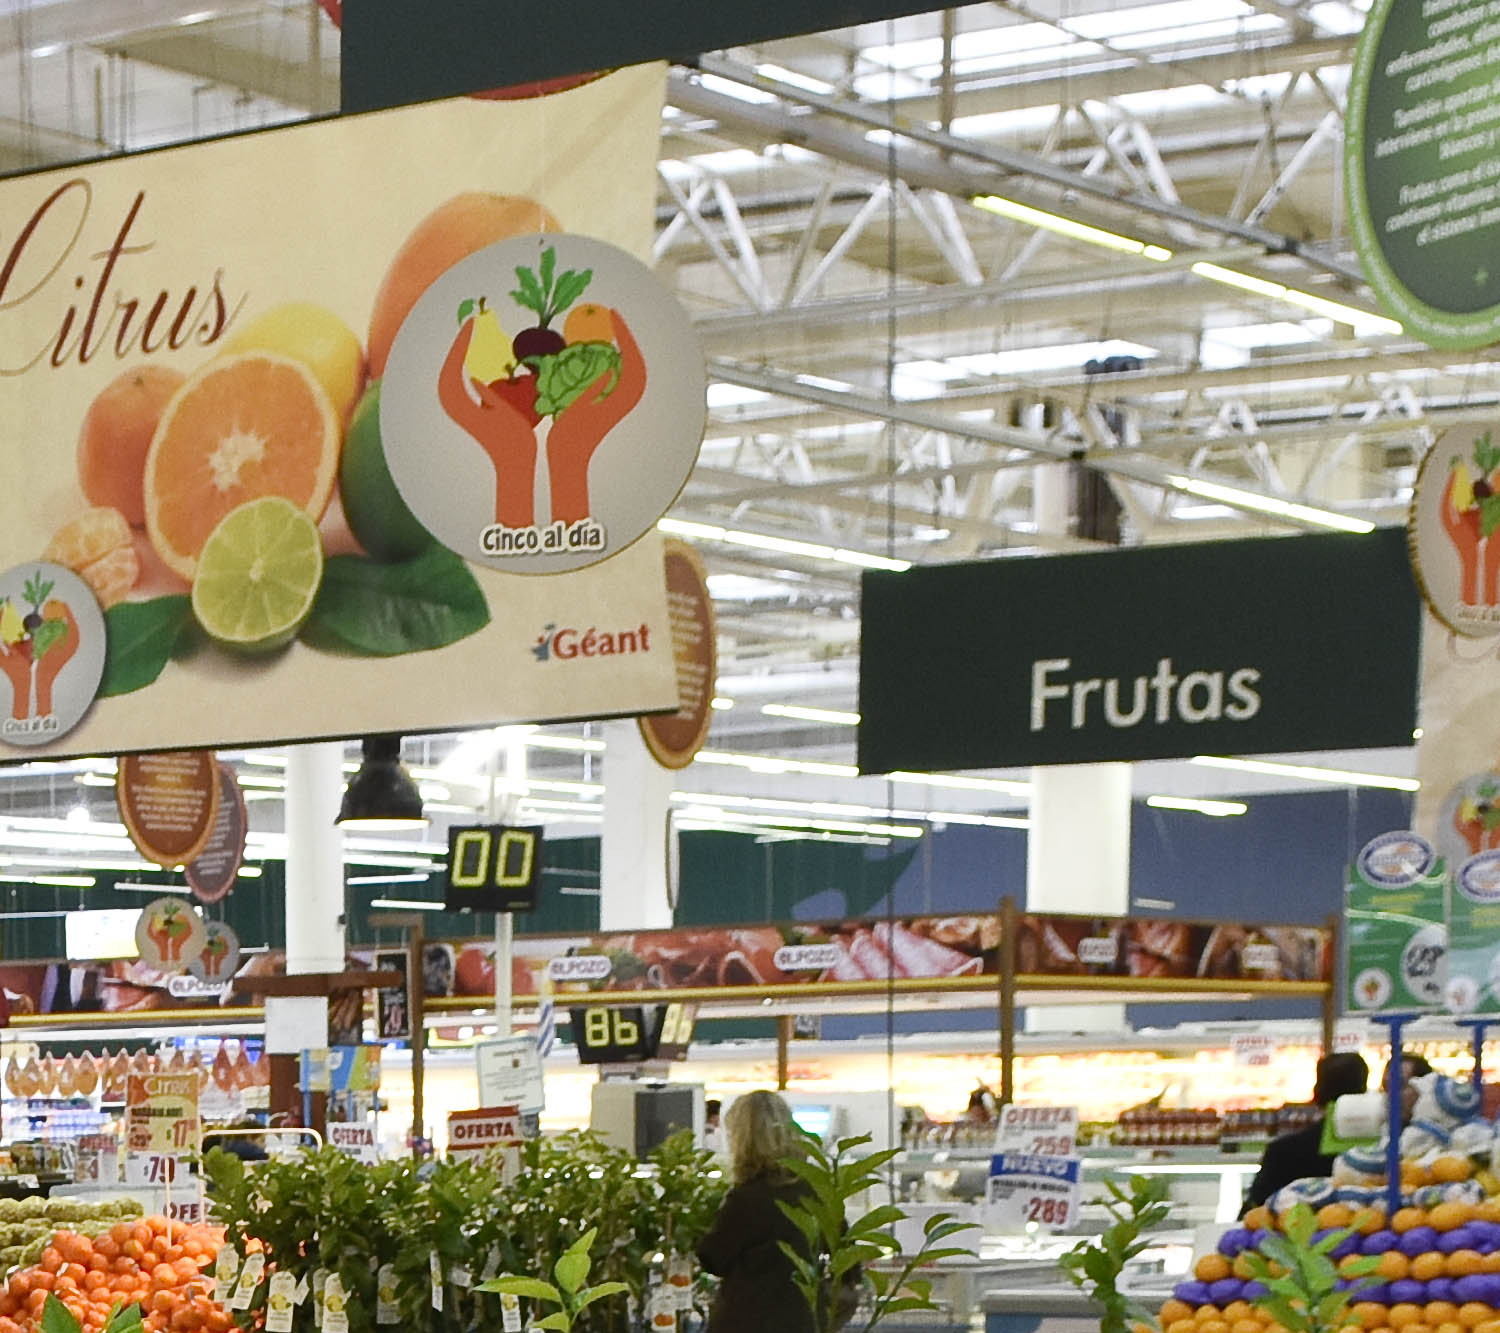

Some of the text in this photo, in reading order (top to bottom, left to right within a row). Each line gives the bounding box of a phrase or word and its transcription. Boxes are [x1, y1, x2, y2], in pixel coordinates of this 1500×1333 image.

[483, 519, 601, 551] Cinco al día
[552, 623, 651, 661] Géant
[1030, 658, 1262, 732] Frutas
[453, 831, 535, 888] 00
[332, 1127, 374, 1147] OFERTA
[454, 1121, 515, 1140] OFERTA
